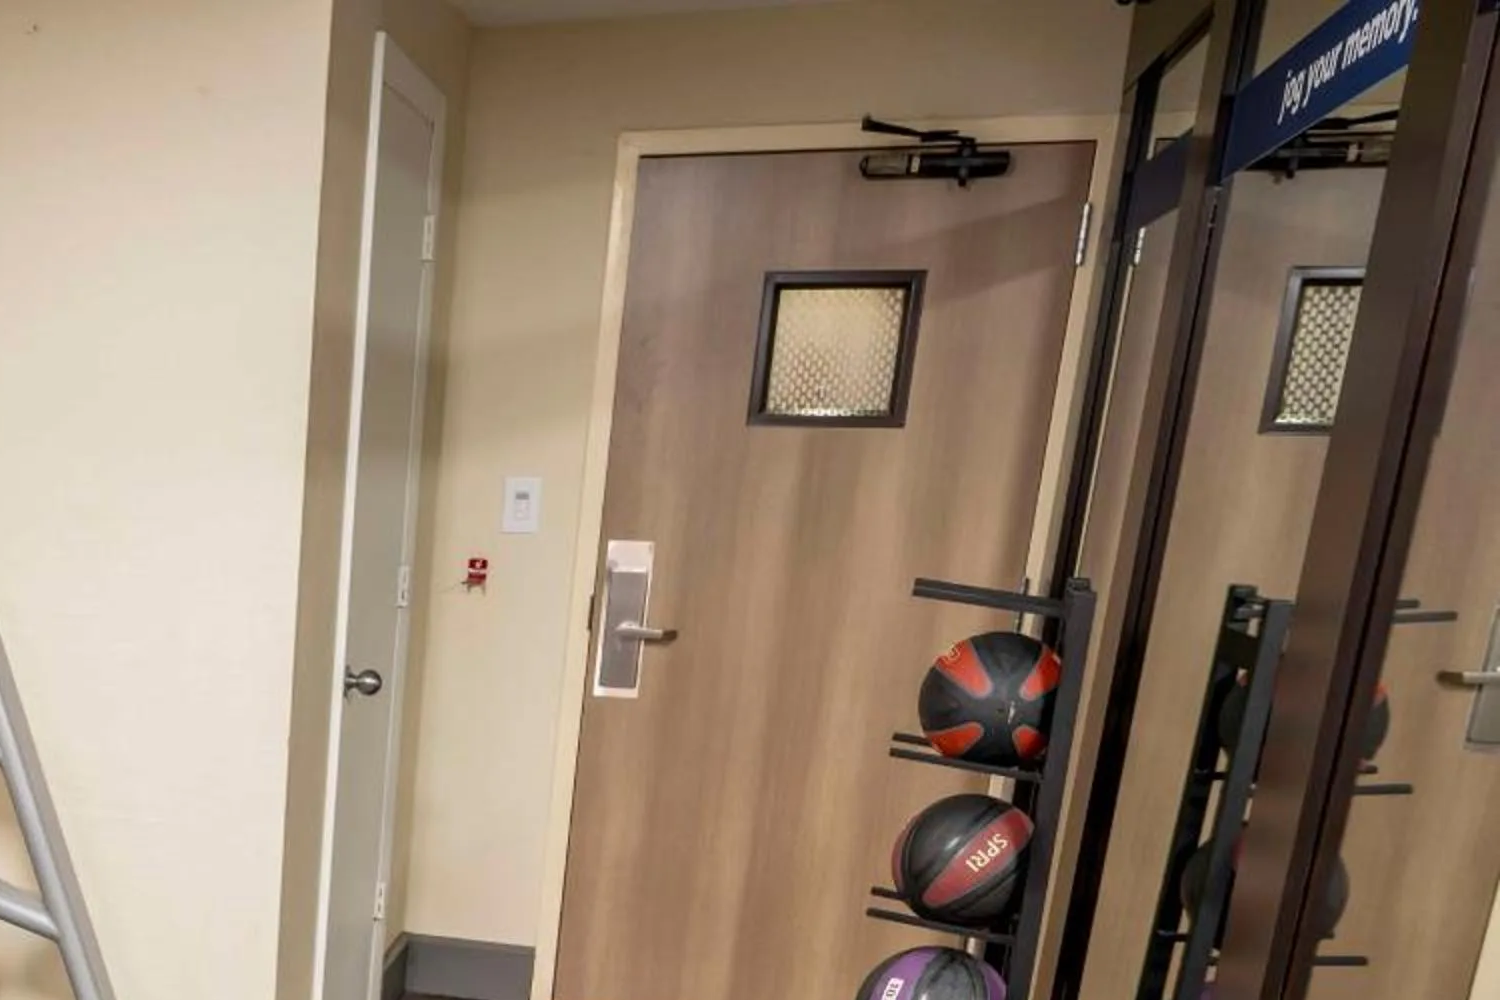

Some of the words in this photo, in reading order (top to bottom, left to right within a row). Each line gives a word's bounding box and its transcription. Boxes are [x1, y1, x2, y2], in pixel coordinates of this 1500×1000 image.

[1277, 69, 1307, 125] jog
[1302, 40, 1344, 109] your
[965, 833, 1008, 873] SPRI
